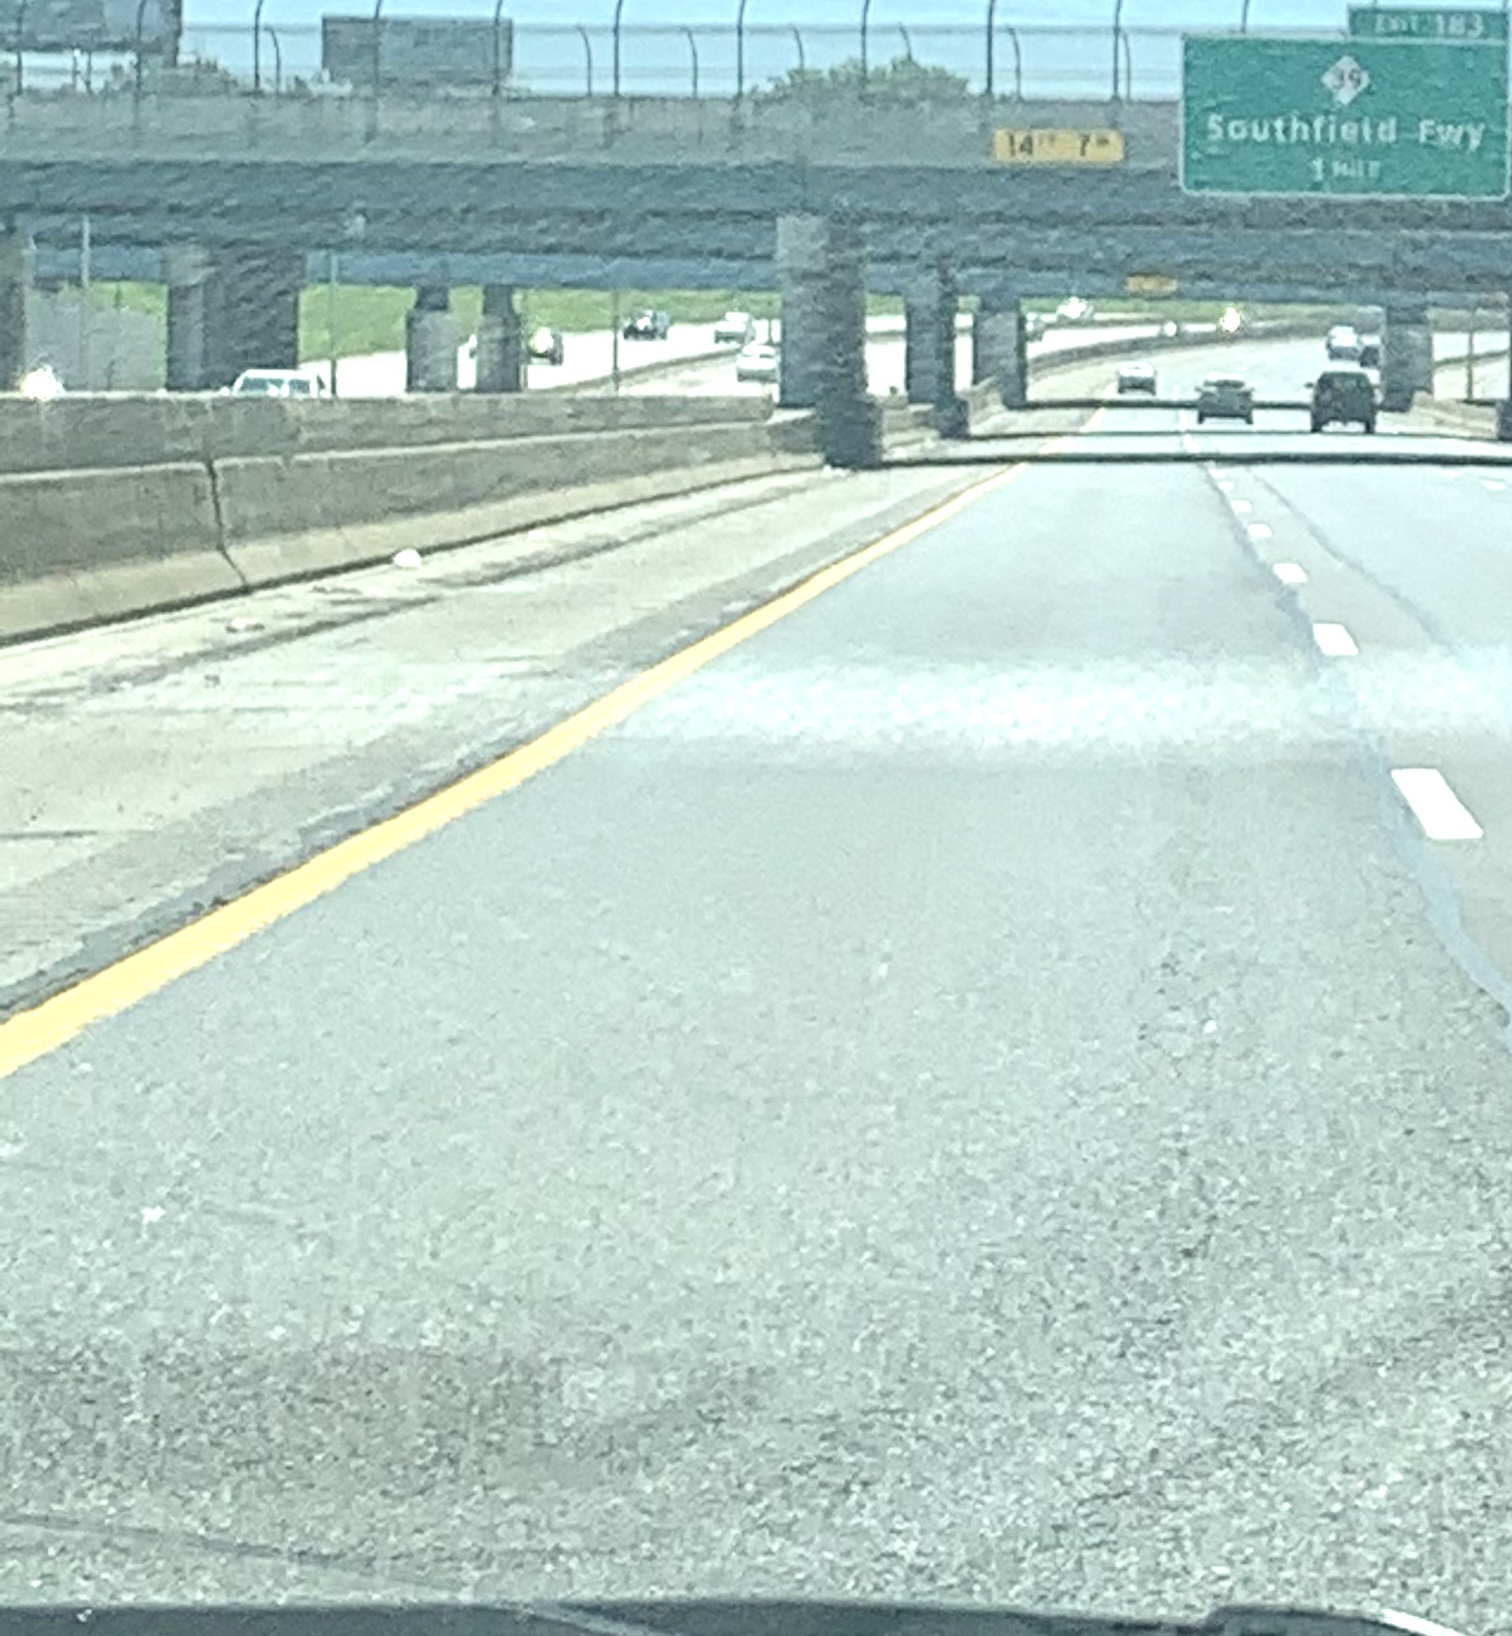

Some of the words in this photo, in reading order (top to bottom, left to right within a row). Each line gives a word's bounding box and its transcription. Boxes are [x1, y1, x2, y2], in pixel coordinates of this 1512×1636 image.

[1436, 12, 1485, 38] 183
[1008, 133, 1034, 157] 14
[1080, 133, 1092, 157] 7
[1206, 112, 1398, 144] Southfield
[1418, 118, 1486, 153] Fwy
[1310, 156, 1324, 180] 1
